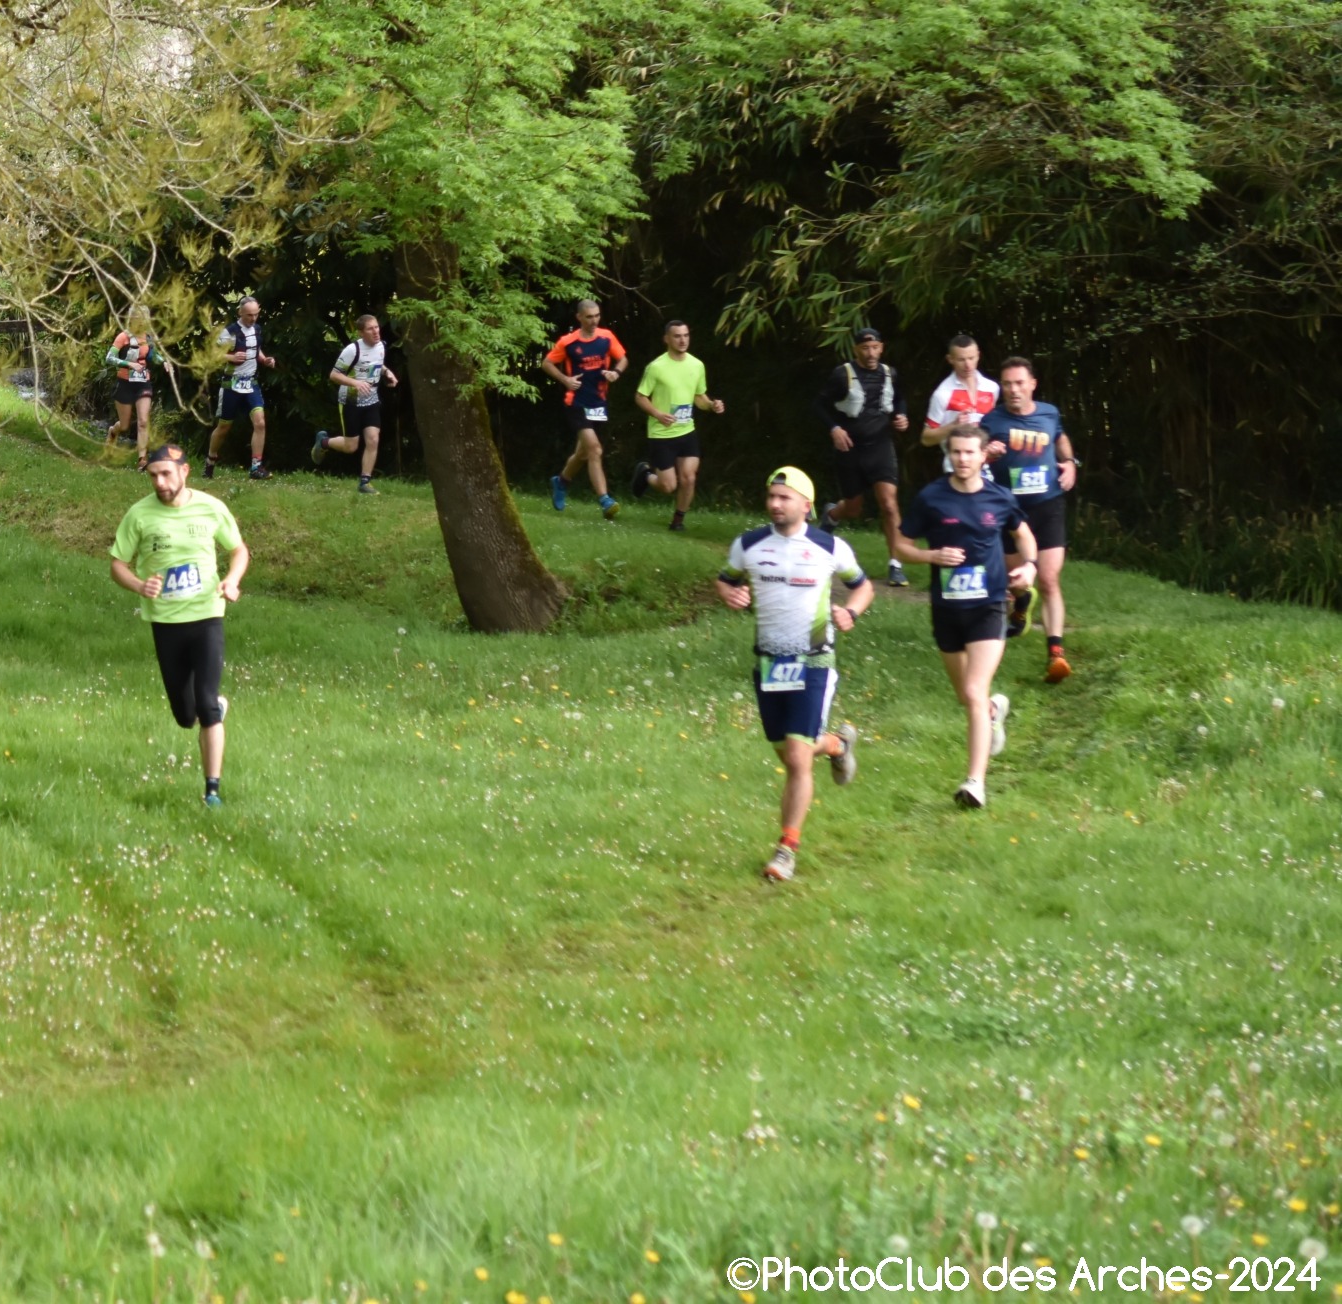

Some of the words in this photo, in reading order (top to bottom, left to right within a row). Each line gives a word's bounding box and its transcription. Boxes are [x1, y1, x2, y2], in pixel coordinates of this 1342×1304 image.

[235, 380, 252, 389] 478
[589, 407, 605, 416] 472
[1009, 428, 1049, 453] UTP
[166, 568, 199, 590] 449
[949, 573, 983, 591] 474
[770, 662, 804, 682] 477
